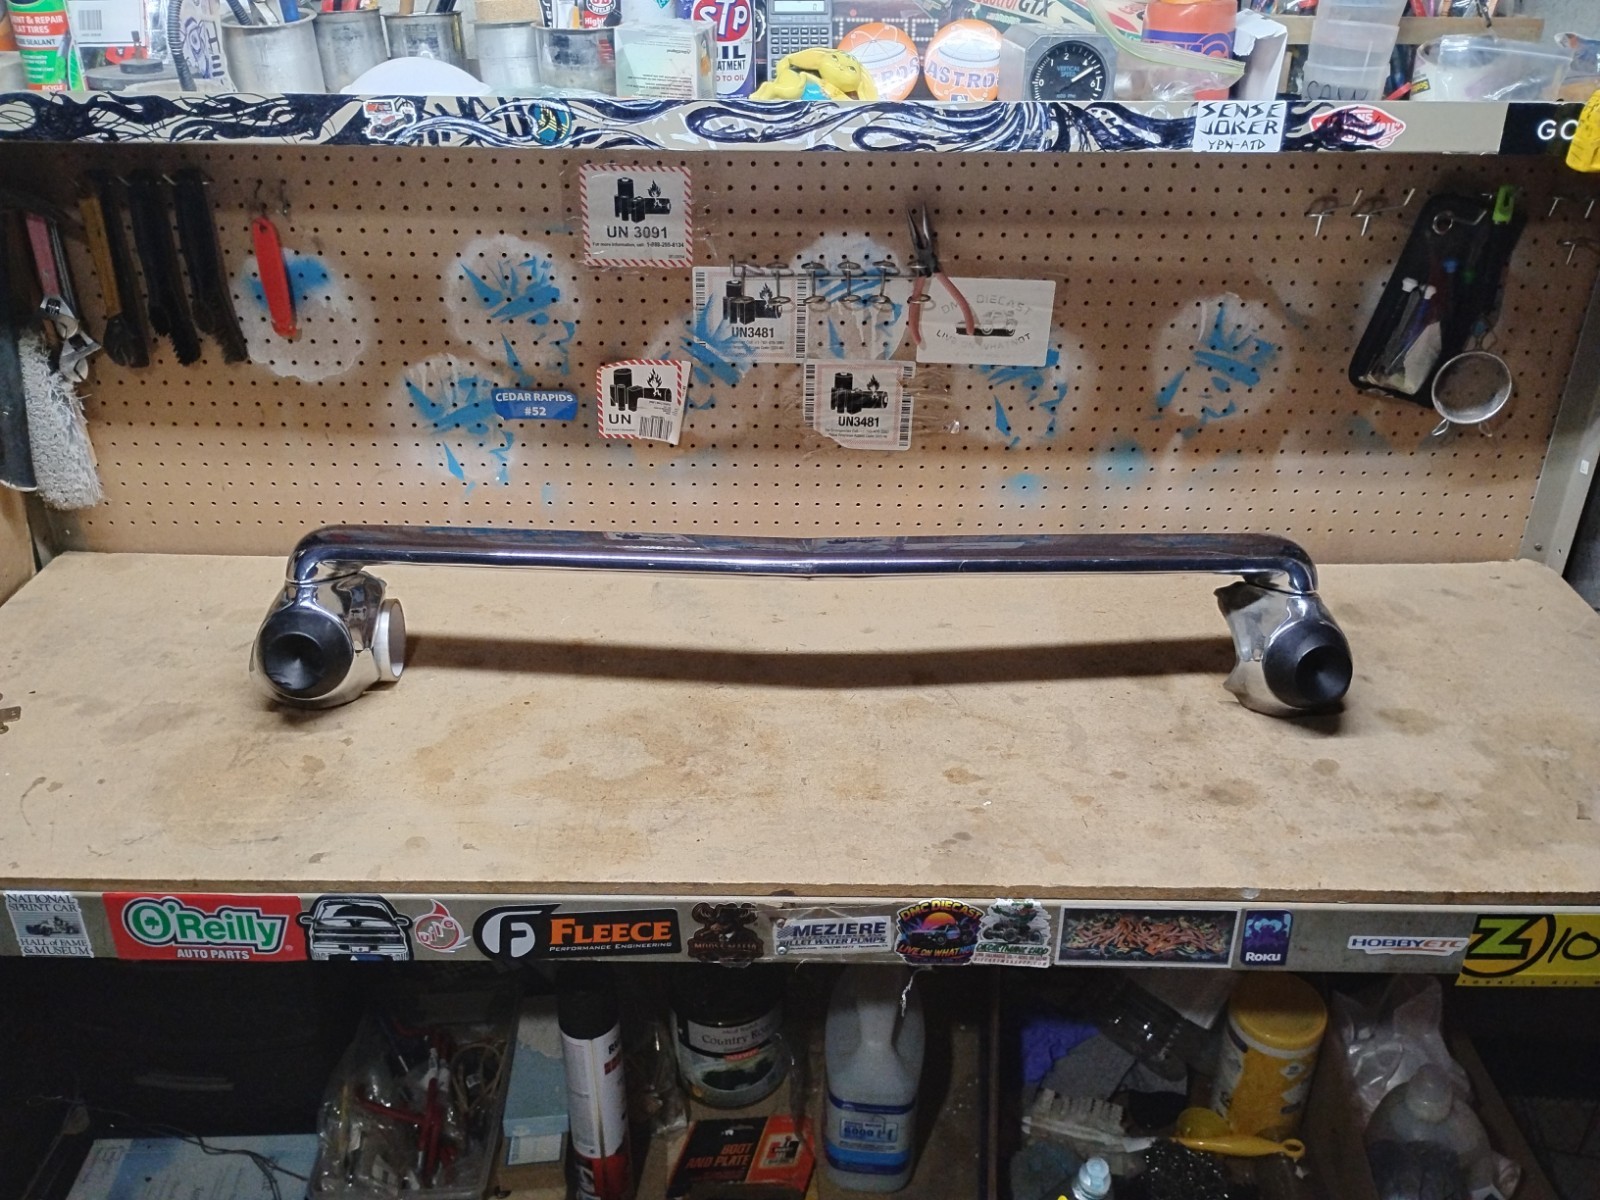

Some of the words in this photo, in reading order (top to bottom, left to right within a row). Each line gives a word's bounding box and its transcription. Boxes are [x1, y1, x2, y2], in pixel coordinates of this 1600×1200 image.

[34, 15, 64, 24] REPAIR
[699, 0, 748, 35] STP
[28, 25, 50, 33] TIRES
[716, 45, 746, 60] IL
[1063, 52, 1070, 60] 2
[717, 60, 746, 71] ATMENT
[722, 74, 732, 82] TO
[926, 60, 999, 88] ASTRO
[1038, 79, 1045, 87] 0
[1200, 102, 1285, 119] SENSE
[1199, 120, 1279, 135] JOKER
[606, 226, 628, 238] UN
[634, 226, 668, 239] 3091
[976, 294, 1033, 316] DIECAST
[731, 327, 775, 338] UN3481
[984, 332, 1031, 350] WHATNOT
[495, 392, 532, 402] CEDAR
[533, 392, 573, 402] RAPIDS
[524, 407, 547, 416] #52
[608, 413, 632, 425] UN
[838, 416, 880, 428] UN3481
[6, 893, 76, 904] NATIONAL
[8, 903, 50, 912] SPRINT
[52, 904, 78, 912] CAR
[900, 901, 931, 921] DMC
[931, 899, 983, 921] DIECAST
[131, 903, 277, 947] O'Reilly
[550, 917, 672, 945] FLEECE
[792, 921, 887, 937] MEZIERE
[20, 938, 48, 946] HALL
[58, 939, 88, 947] FAME
[614, 942, 672, 950] ENGINEERING
[23, 946, 34, 954] &
[34, 946, 90, 955] MUSEUM
[176, 948, 208, 958] AUTO
[210, 949, 250, 960] PARTS
[899, 944, 920, 955] LIVE
[920, 948, 933, 956] ON
[934, 943, 975, 957] WHATNO
[702, 1034, 748, 1046] Country
[721, 1143, 753, 1155] BOOT
[687, 1156, 714, 1169] AND
[714, 1154, 750, 1167] PLATE
